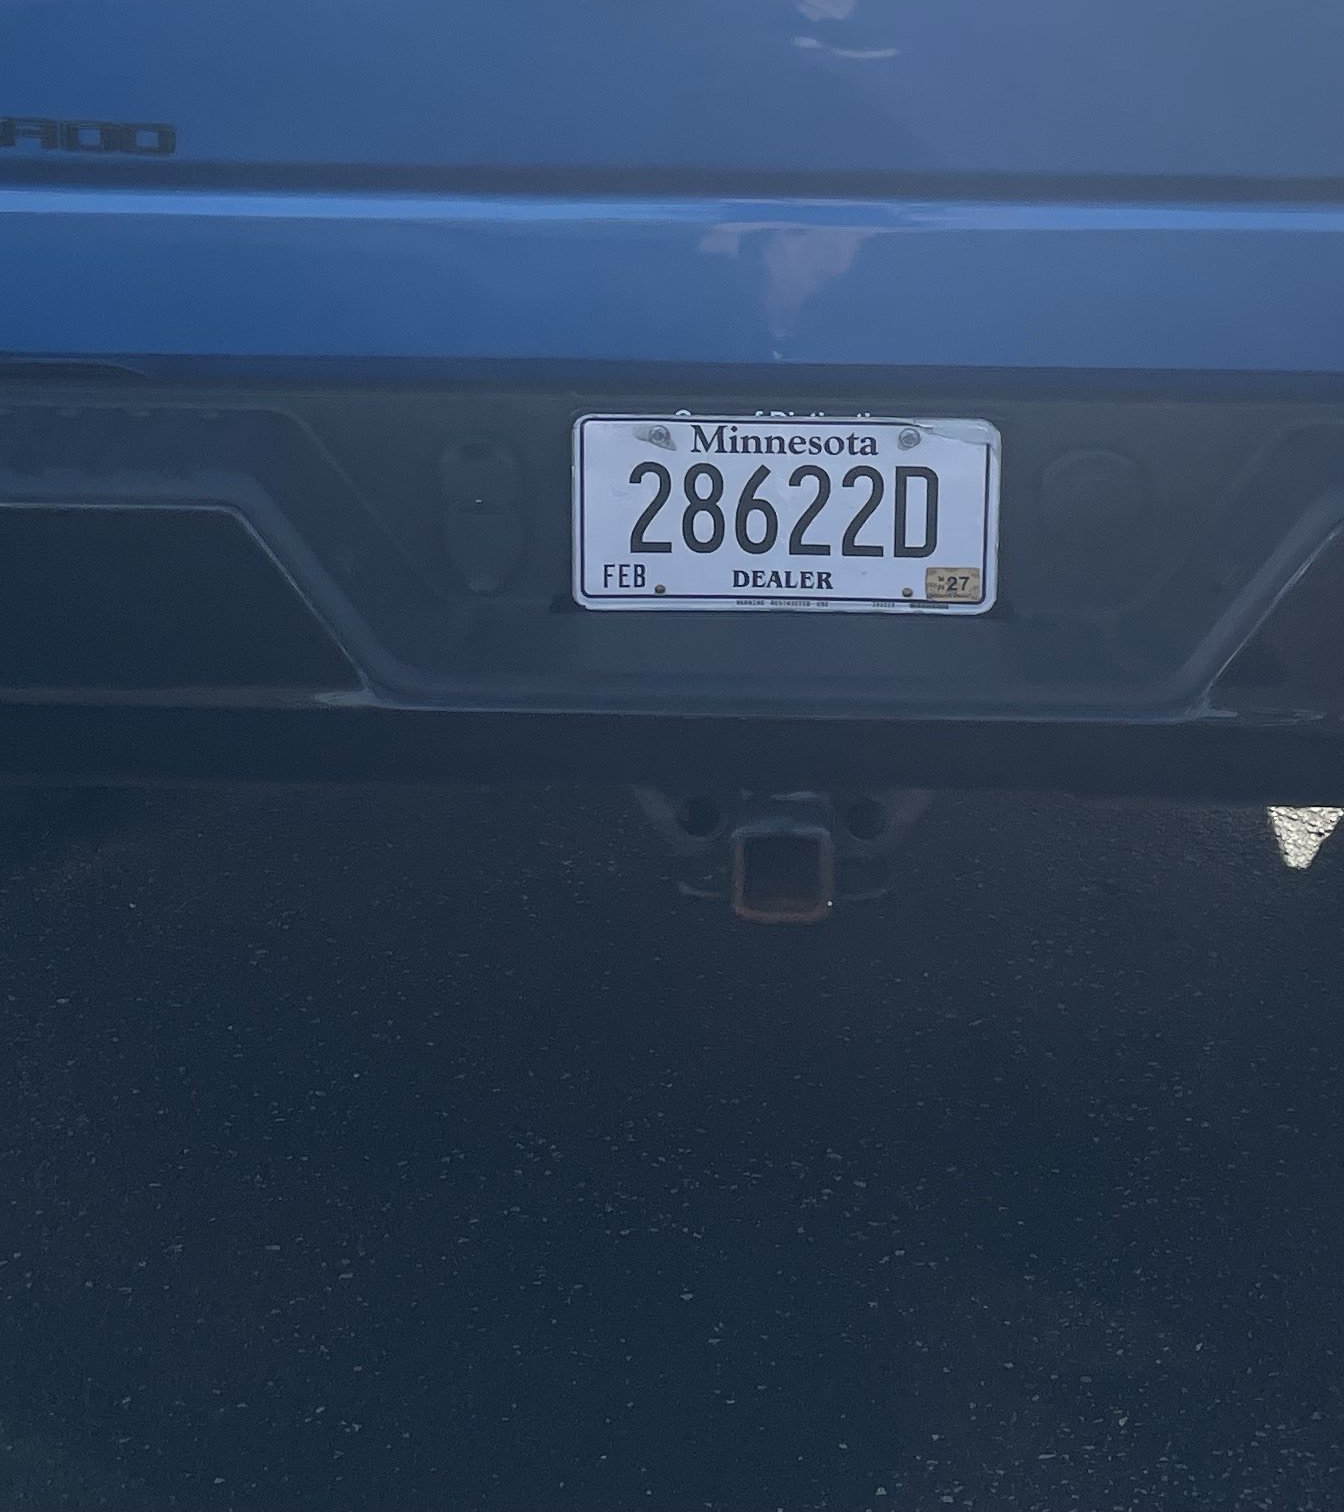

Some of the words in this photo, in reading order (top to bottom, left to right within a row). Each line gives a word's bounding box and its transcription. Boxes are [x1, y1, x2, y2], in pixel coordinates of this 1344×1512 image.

[690, 424, 879, 457] Minnesota
[628, 460, 940, 558] 28622D
[602, 563, 647, 589] FEB
[731, 569, 834, 590] DEALER
[947, 576, 970, 591] 27
